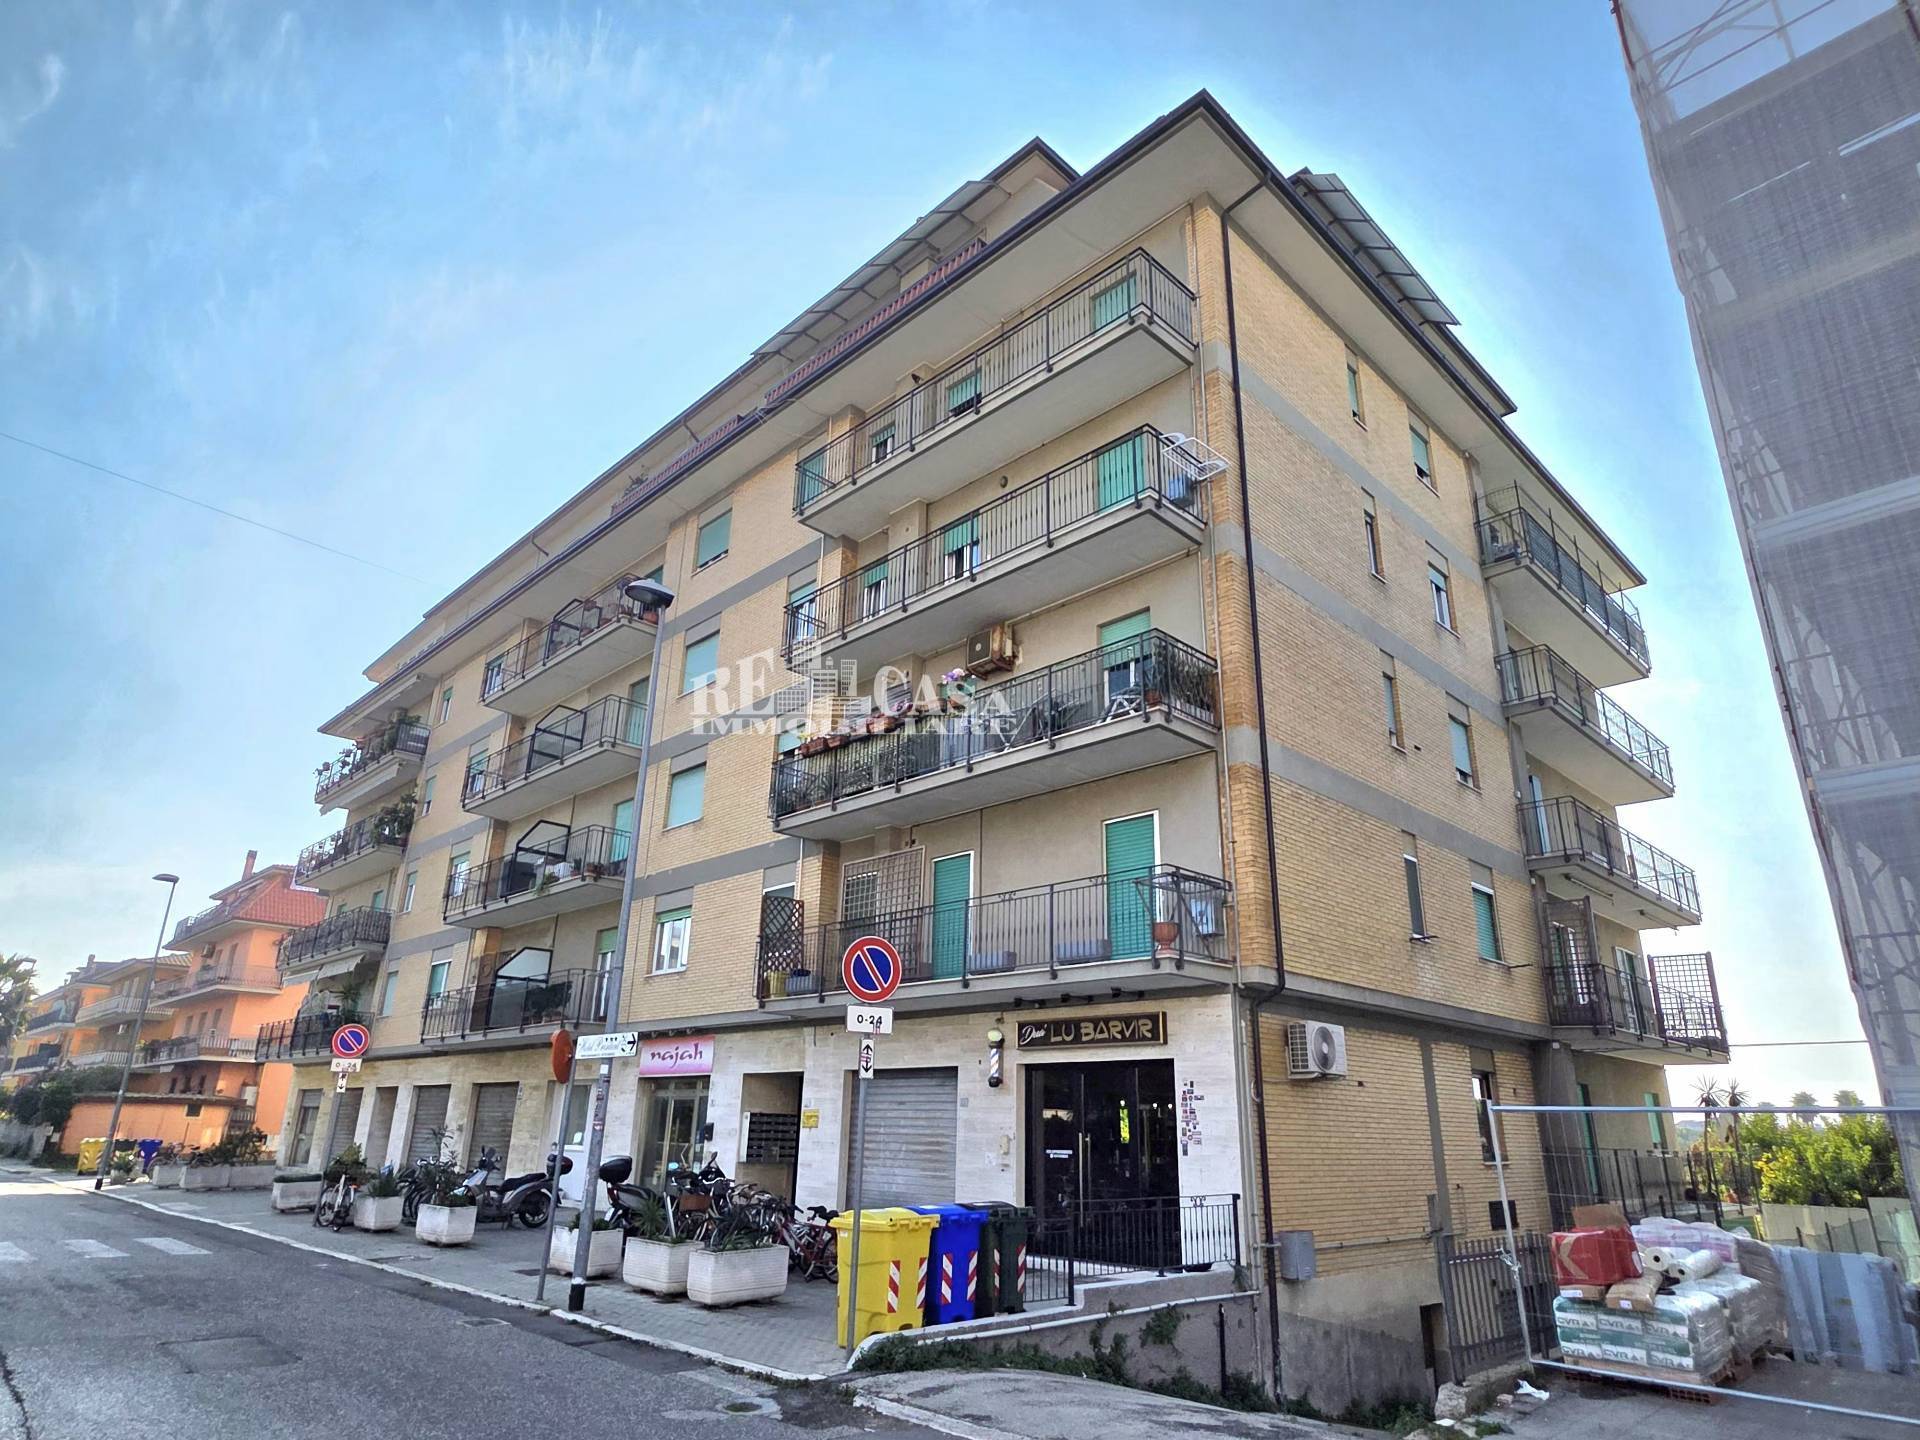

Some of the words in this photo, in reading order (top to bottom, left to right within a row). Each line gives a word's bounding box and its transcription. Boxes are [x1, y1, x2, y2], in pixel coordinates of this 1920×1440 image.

[856, 1014, 883, 1025] 0-24
[1050, 1023, 1075, 1043] LU
[1080, 1018, 1153, 1042] BARVIR
[650, 1042, 703, 1069] najah
